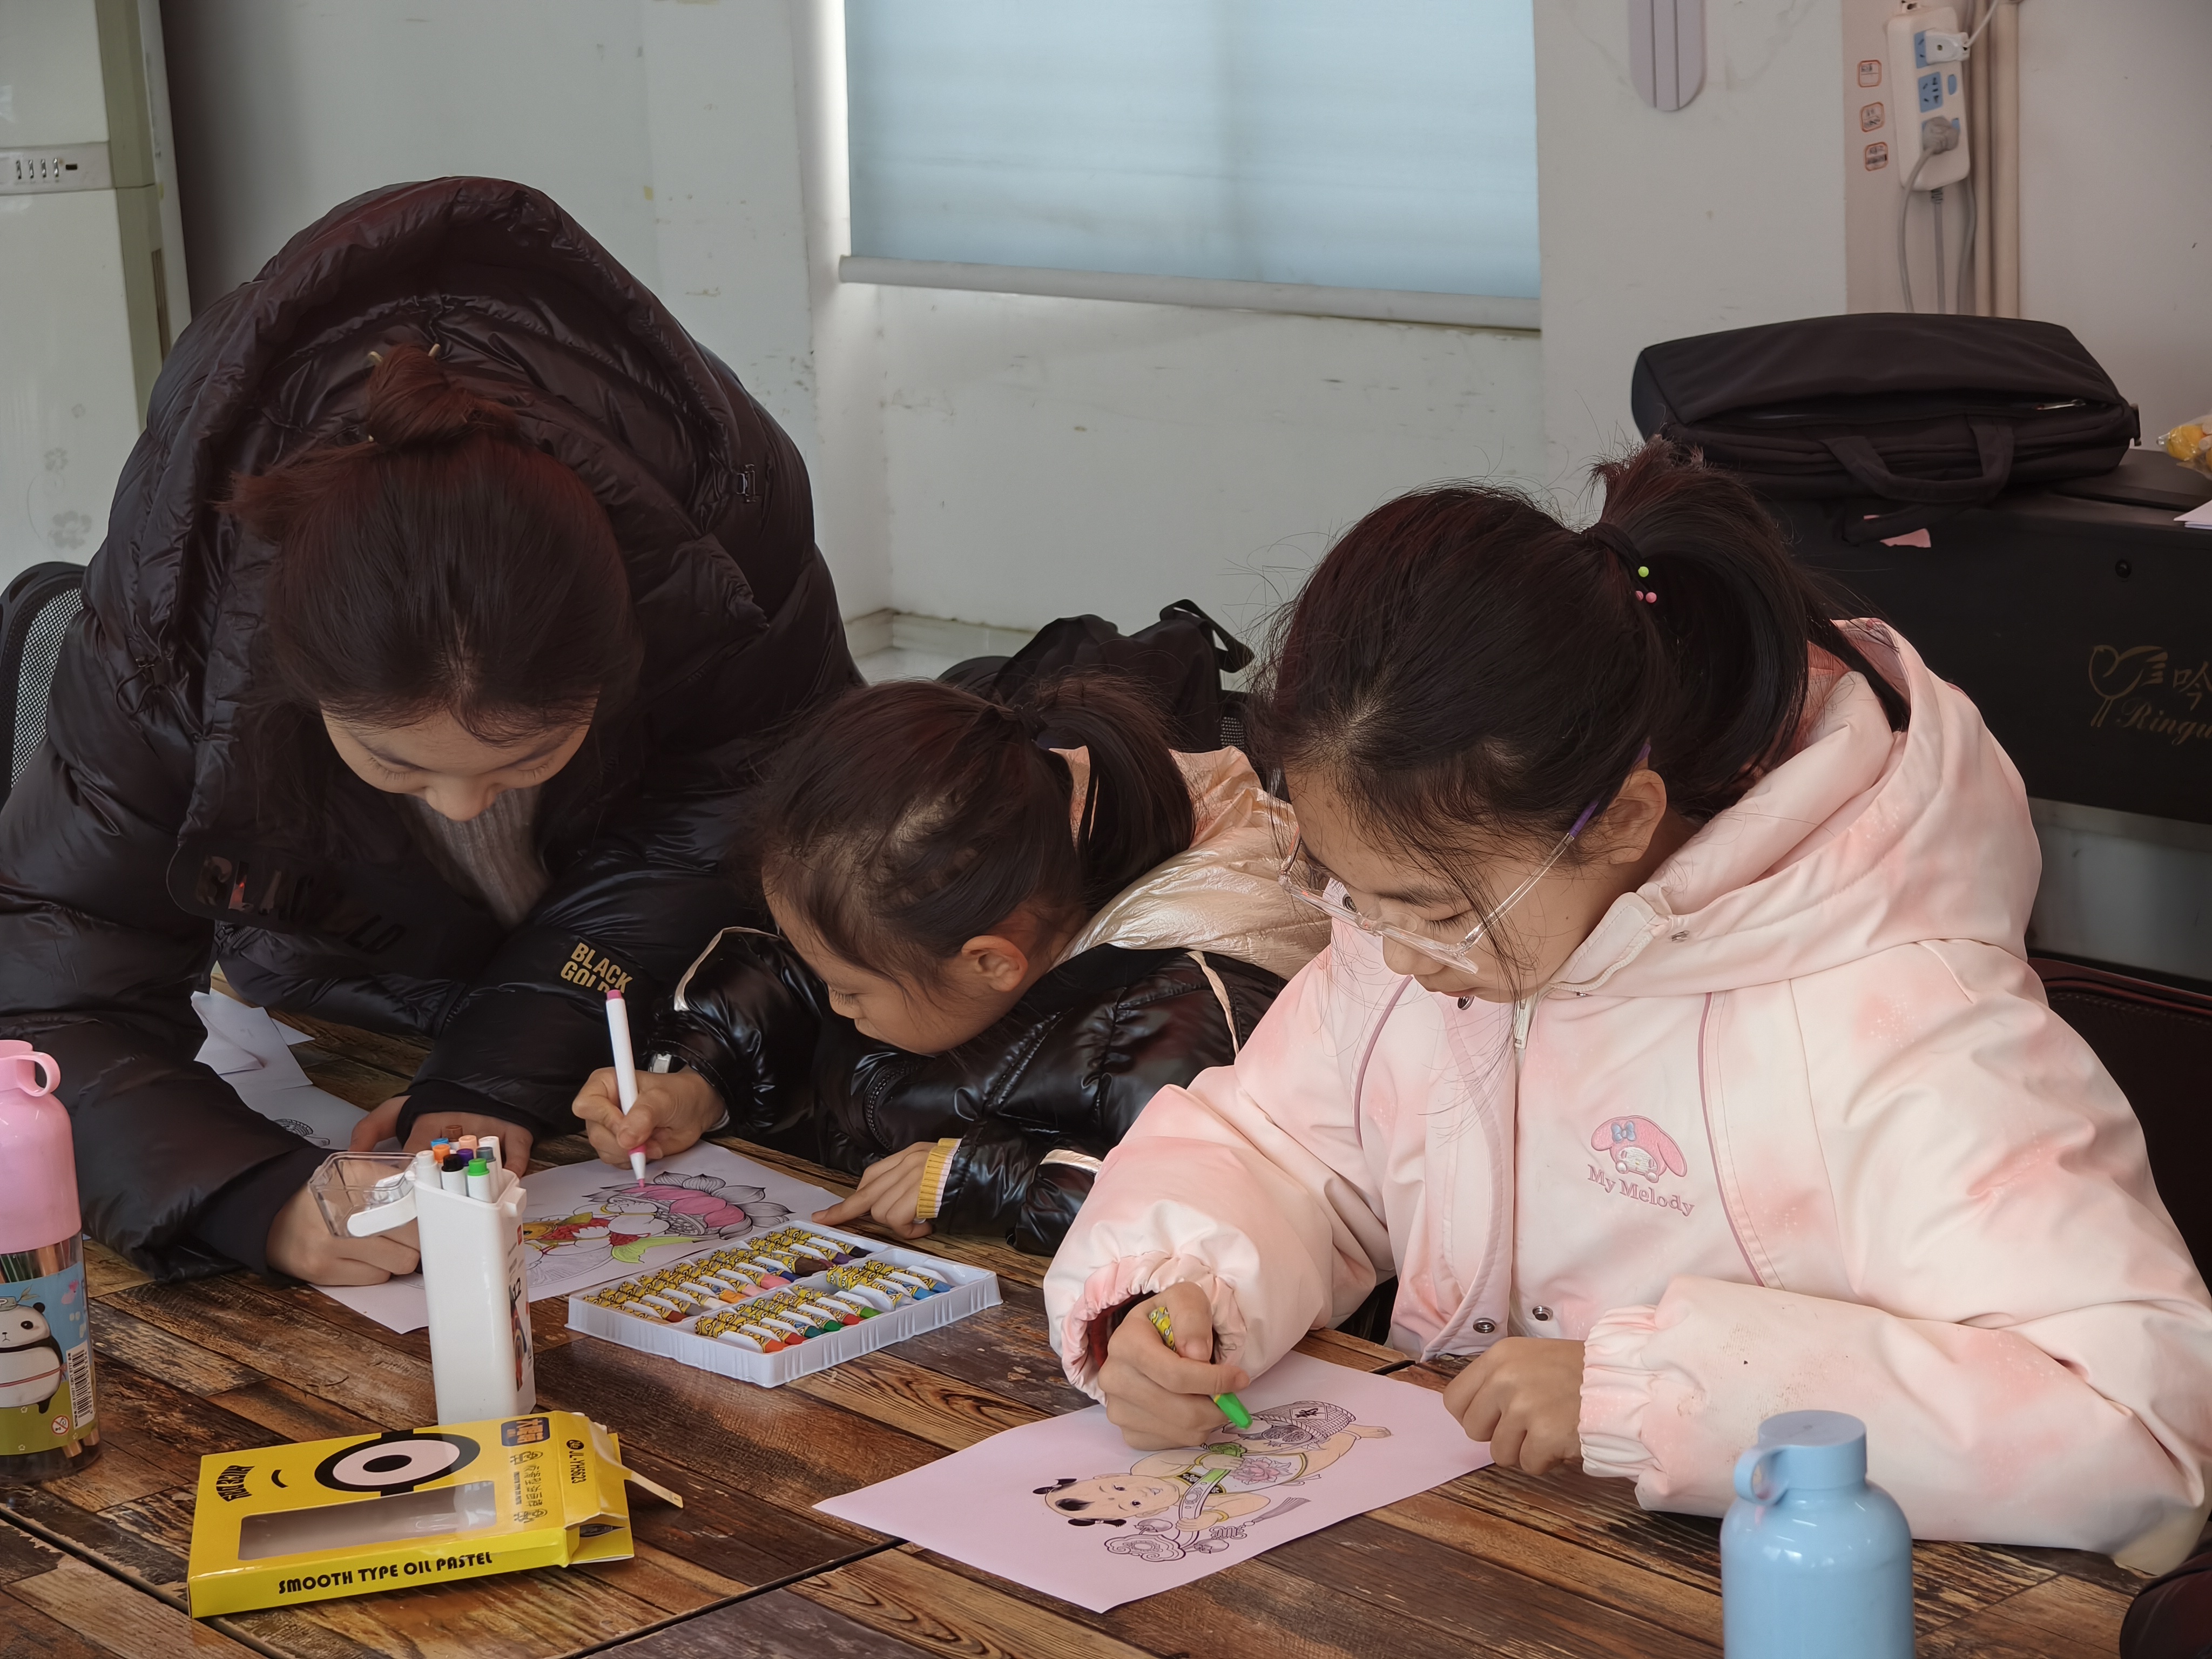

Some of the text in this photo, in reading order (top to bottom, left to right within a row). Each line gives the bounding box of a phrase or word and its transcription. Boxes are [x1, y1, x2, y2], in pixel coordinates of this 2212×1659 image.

[571, 942, 633, 994] BLACK
[1587, 1164, 1695, 1216] My Melody
[279, 1552, 493, 1594] SMOOTH TYPE OIL PASTEL
